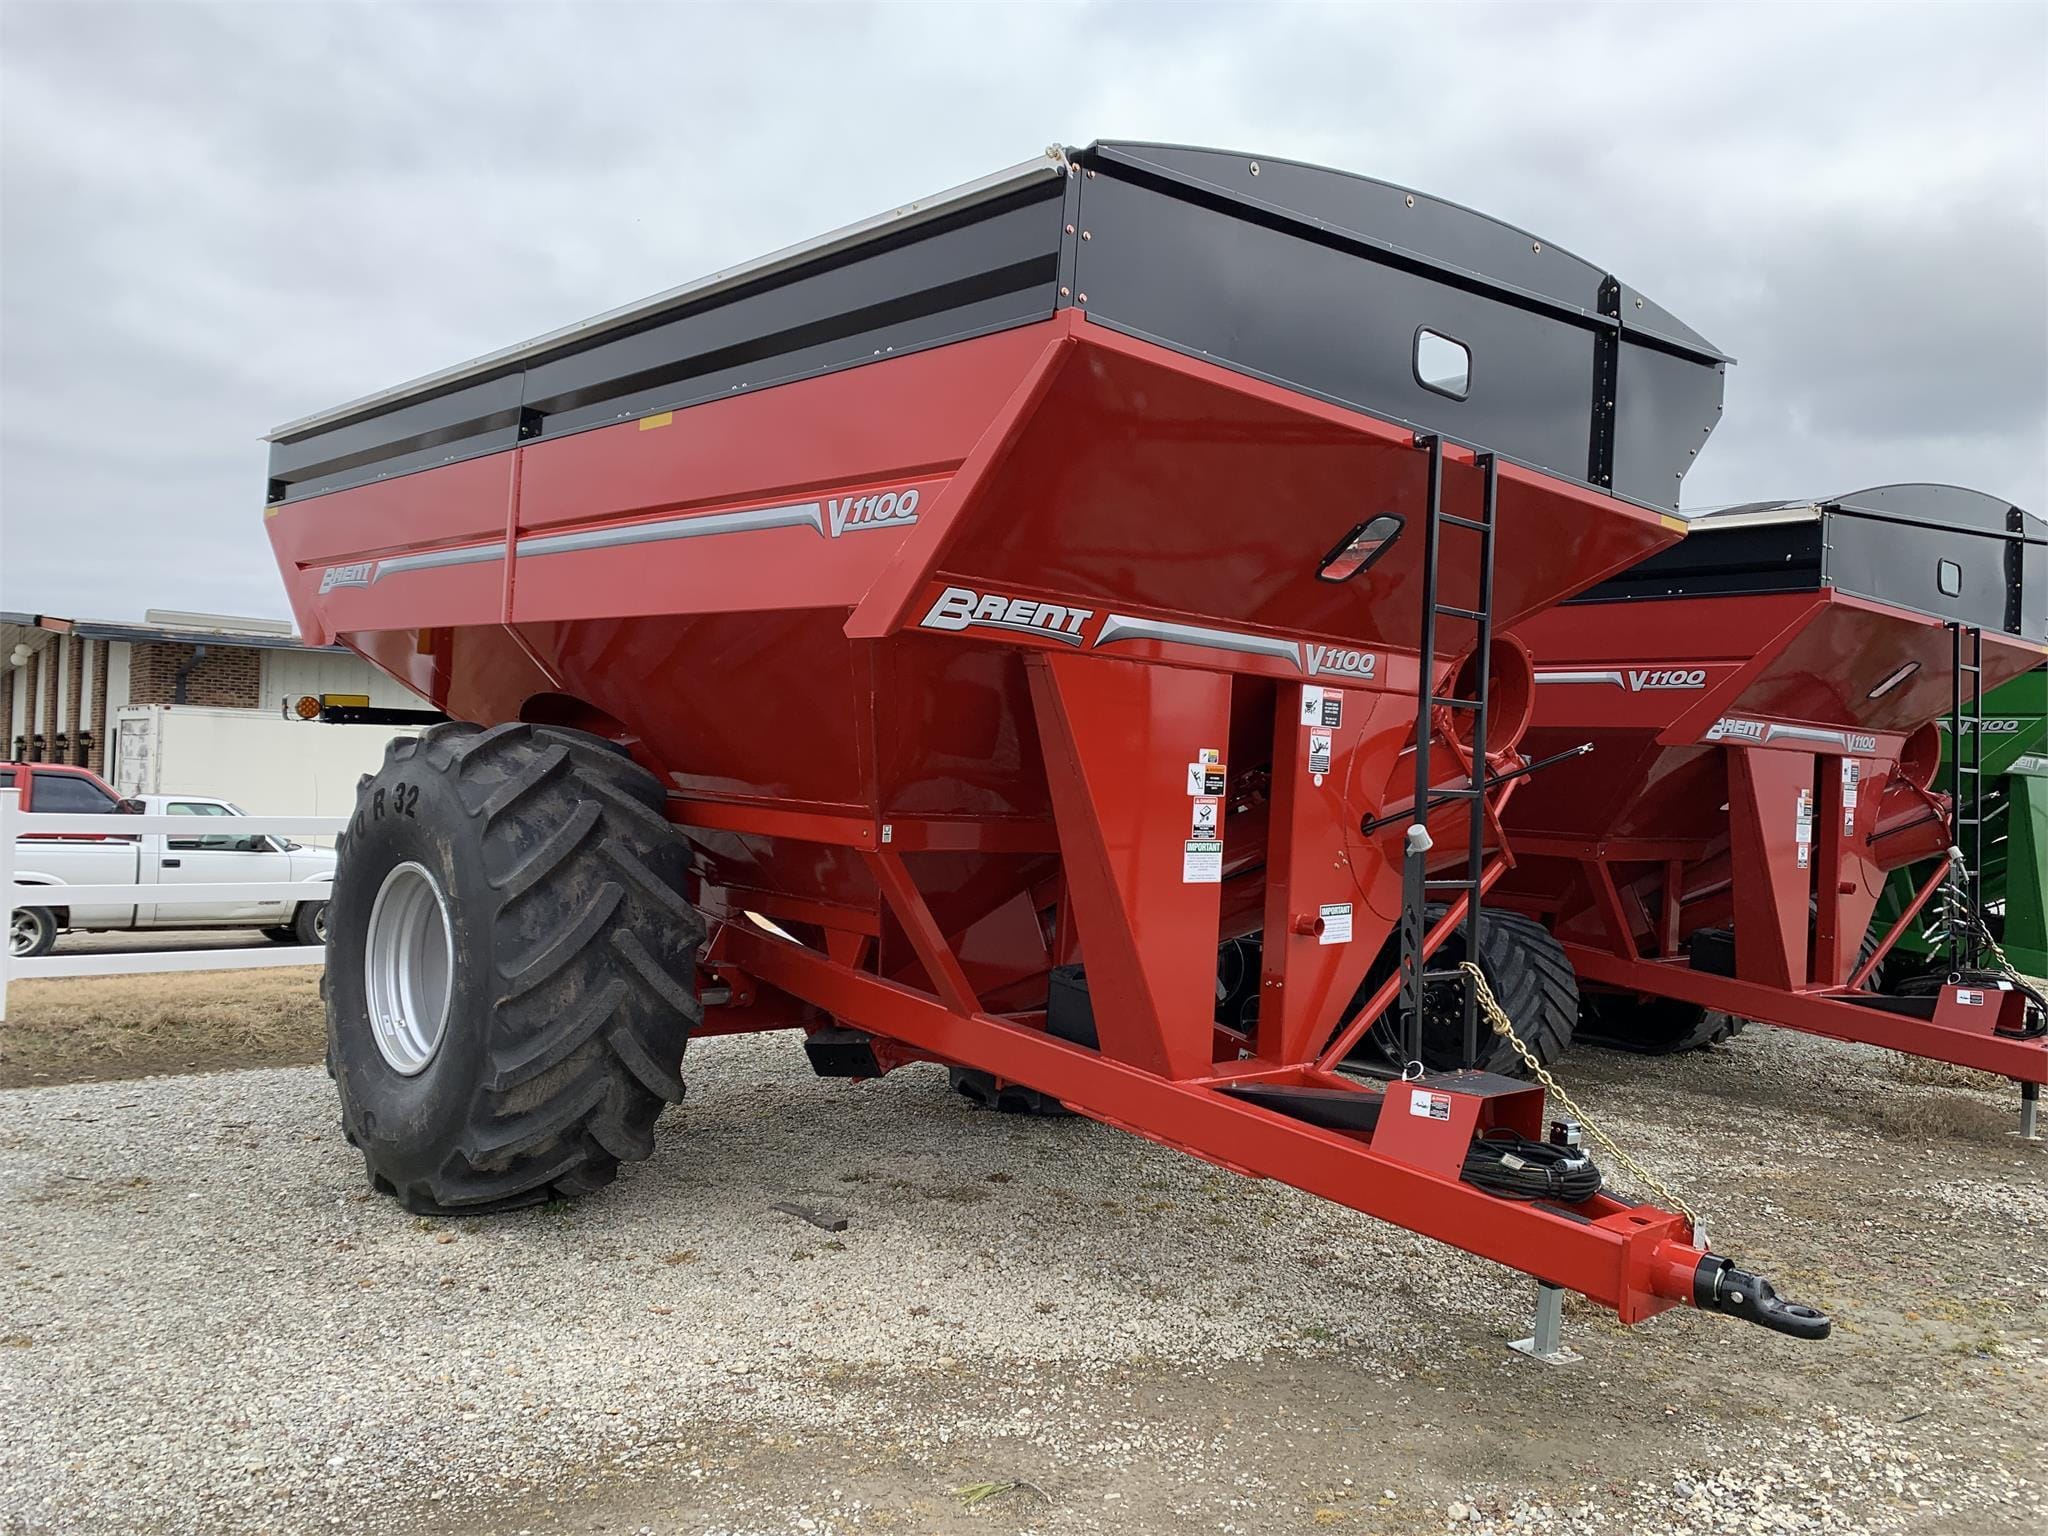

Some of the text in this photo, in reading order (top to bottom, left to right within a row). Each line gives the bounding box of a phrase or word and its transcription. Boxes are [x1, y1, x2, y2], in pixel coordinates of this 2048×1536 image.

[828, 489, 919, 538] V1100
[319, 563, 372, 594] BRENT
[920, 587, 1094, 638] BRENT
[1305, 643, 1376, 676] V1100
[1628, 670, 1706, 692] V1100
[1846, 733, 1876, 752] V1100
[373, 782, 420, 821] R 32
[1186, 842, 1221, 852] IMPORTANT
[1321, 905, 1351, 916] IMPORTANT
